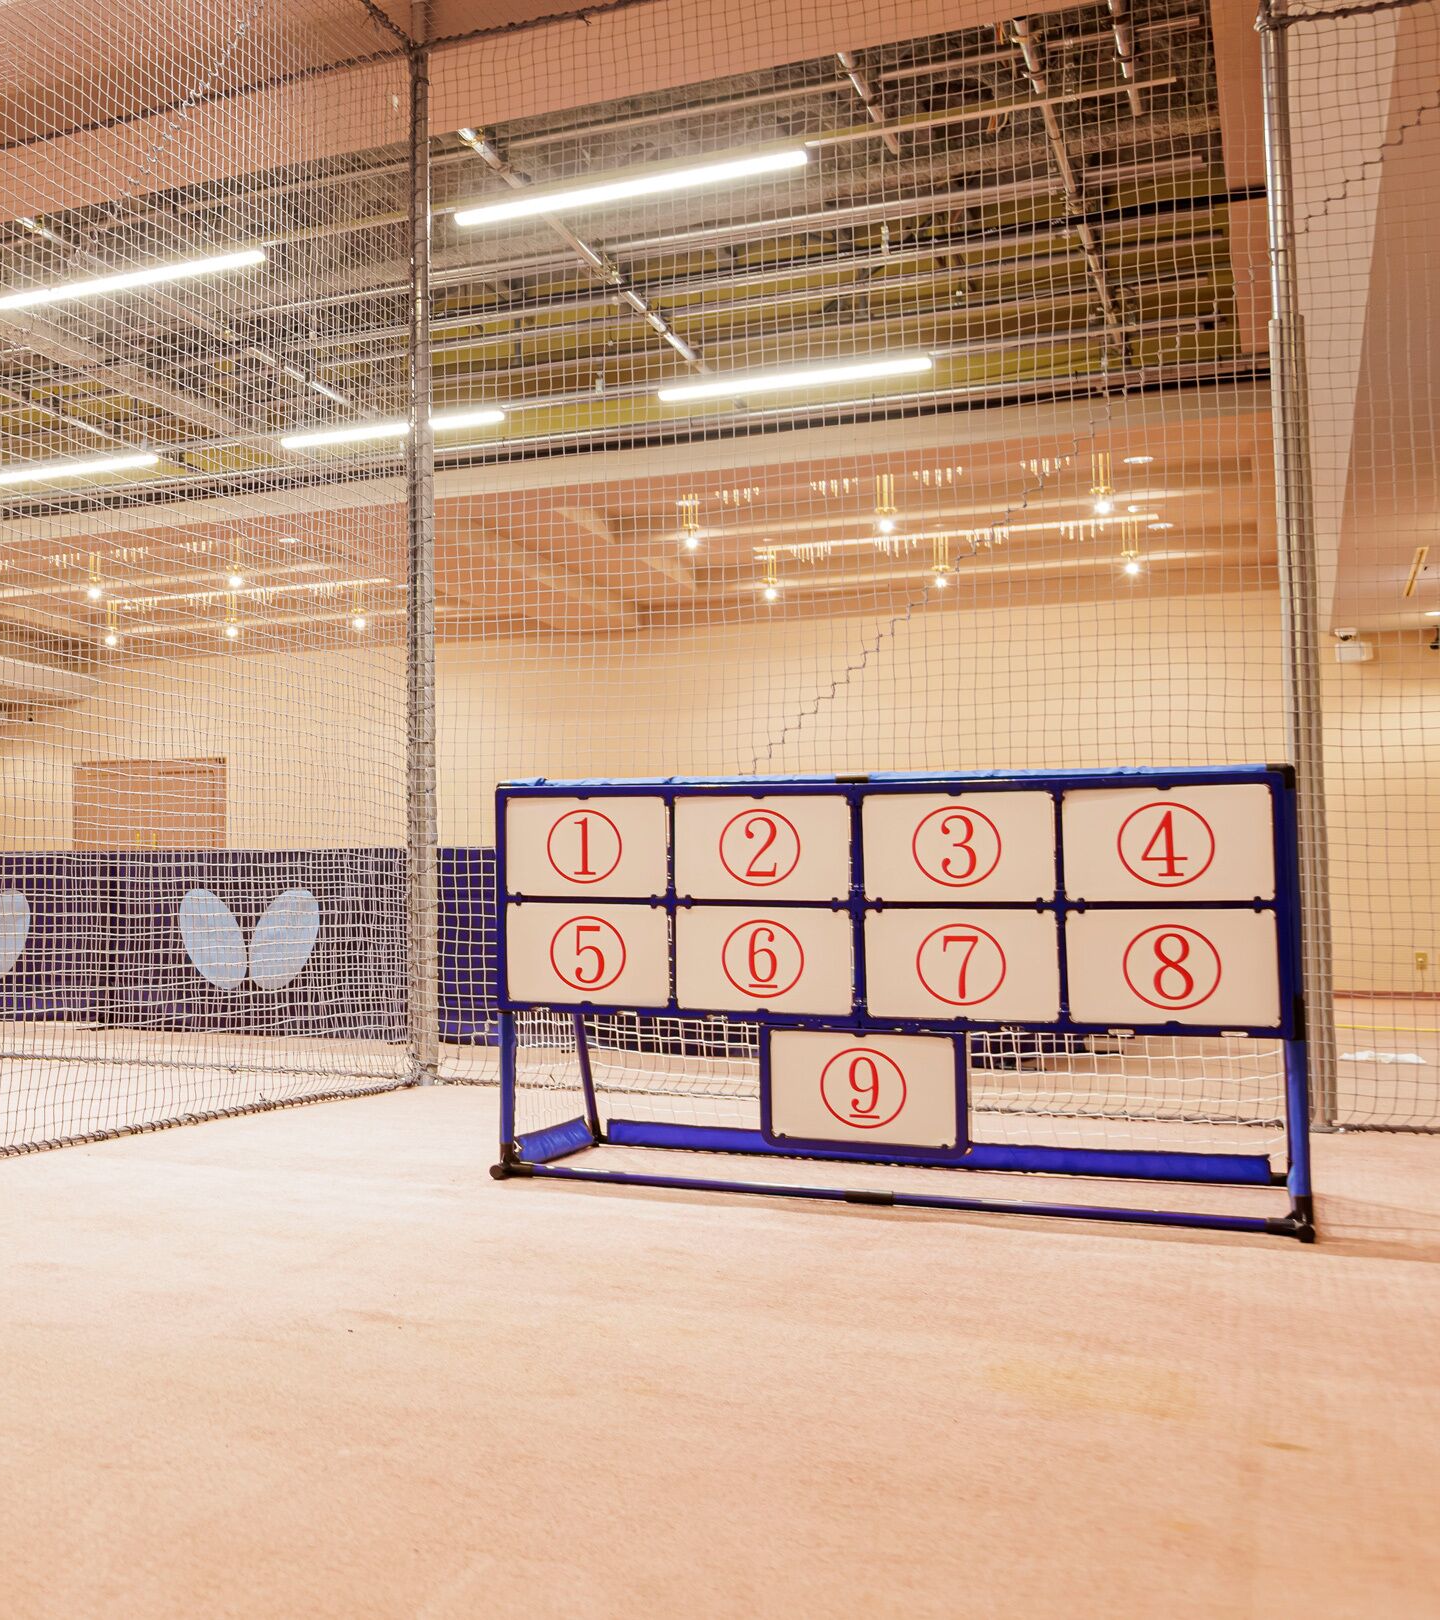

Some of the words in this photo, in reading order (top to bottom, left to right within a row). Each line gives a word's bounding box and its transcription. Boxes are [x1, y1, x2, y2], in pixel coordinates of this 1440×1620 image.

[574, 818, 595, 876] 1
[745, 817, 776, 878] 2
[941, 815, 976, 879] 3
[1142, 810, 1187, 877] 4
[575, 926, 604, 984] 5
[749, 928, 778, 984] 6
[943, 936, 979, 1000] 7
[1154, 933, 1194, 1001] 8
[849, 1057, 879, 1113] 9
